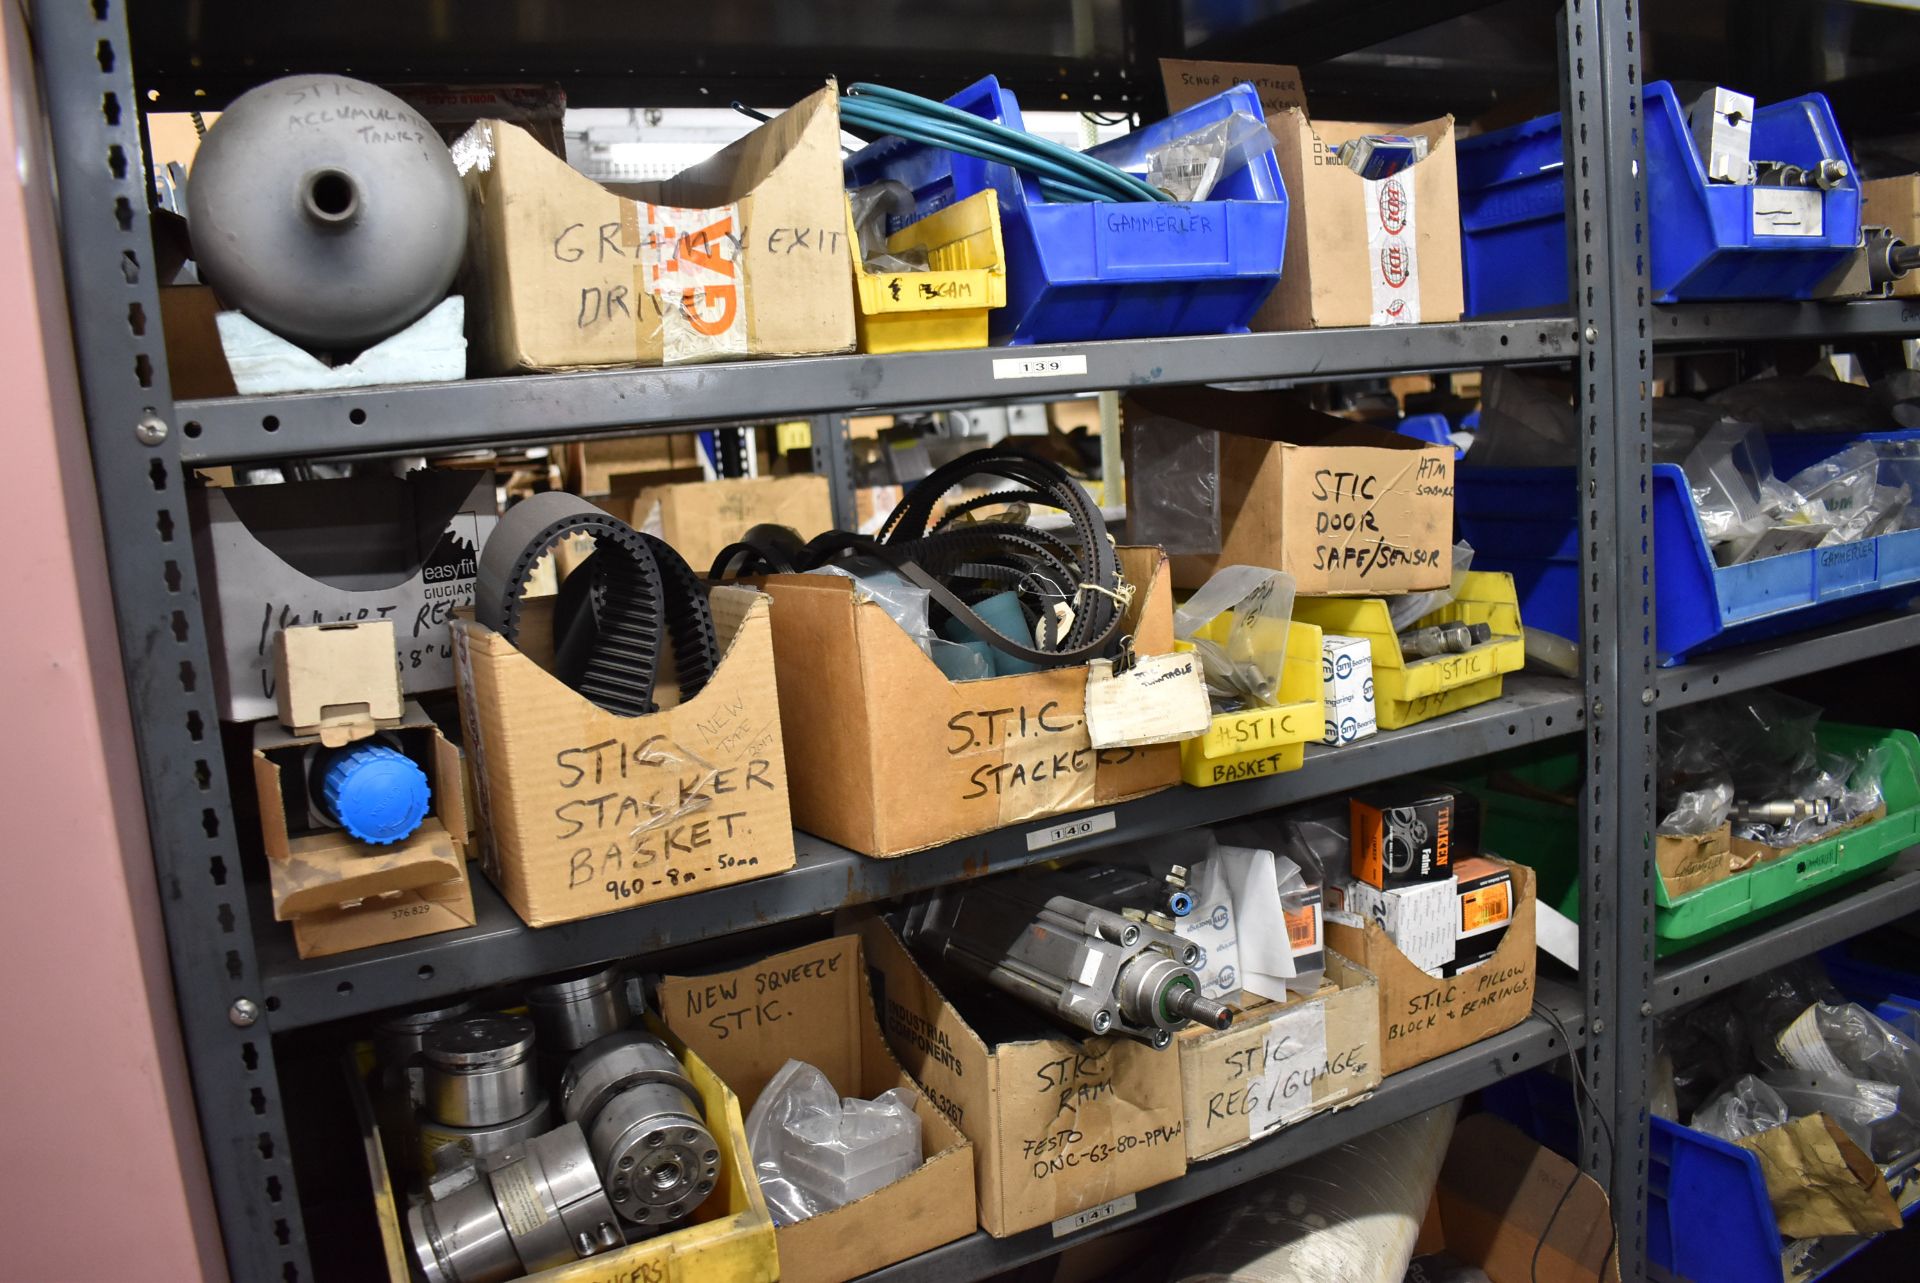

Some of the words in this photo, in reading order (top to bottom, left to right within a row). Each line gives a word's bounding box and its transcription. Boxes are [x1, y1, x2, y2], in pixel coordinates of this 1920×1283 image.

[767, 225, 847, 255] EXIT
[1023, 361, 1060, 372] 139
[1312, 469, 1378, 503] STIC
[1316, 510, 1380, 534] DOOR
[424, 558, 476, 581] easyfit
[1312, 536, 1441, 578] SAFE/SENSOR
[1443, 658, 1481, 681] STIC
[696, 690, 744, 745] NEW
[1213, 753, 1282, 782] BASKET
[555, 759, 775, 840] STACKER
[1055, 823, 1092, 839] 140
[1436, 806, 1449, 867] TIMKEN
[605, 878, 645, 901] 960
[1479, 960, 1526, 991] PILLOW
[686, 978, 738, 1018] NEW
[888, 1000, 952, 1052] INDUSTRIAL
[1388, 1013, 1436, 1041] BLOCK
[1224, 1036, 1294, 1081] STIC
[1057, 1077, 1115, 1117] RAM
[1023, 1129, 1083, 1160] FESTO
[1079, 1204, 1112, 1225] 141
